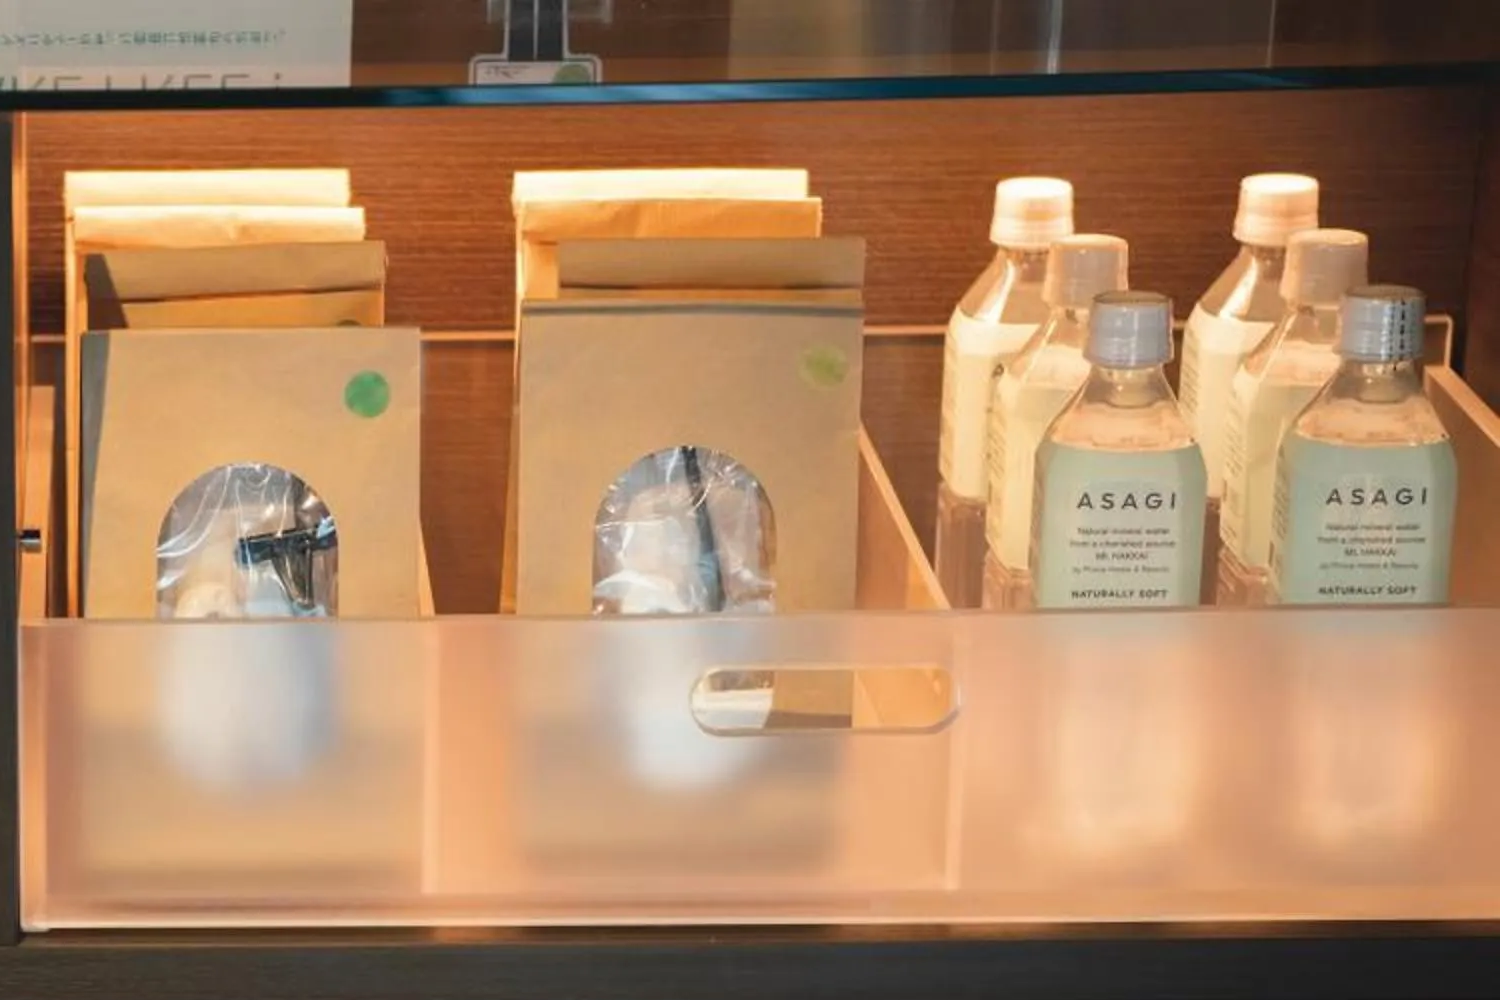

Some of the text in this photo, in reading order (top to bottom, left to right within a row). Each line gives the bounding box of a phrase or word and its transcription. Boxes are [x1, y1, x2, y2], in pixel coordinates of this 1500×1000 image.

[1076, 492, 1177, 510] ASAGI
[1325, 487, 1427, 505] ASAGI
[1071, 589, 1168, 599] NATURALLY SOFT
[1318, 585, 1417, 595] NATURALLY SOFT
